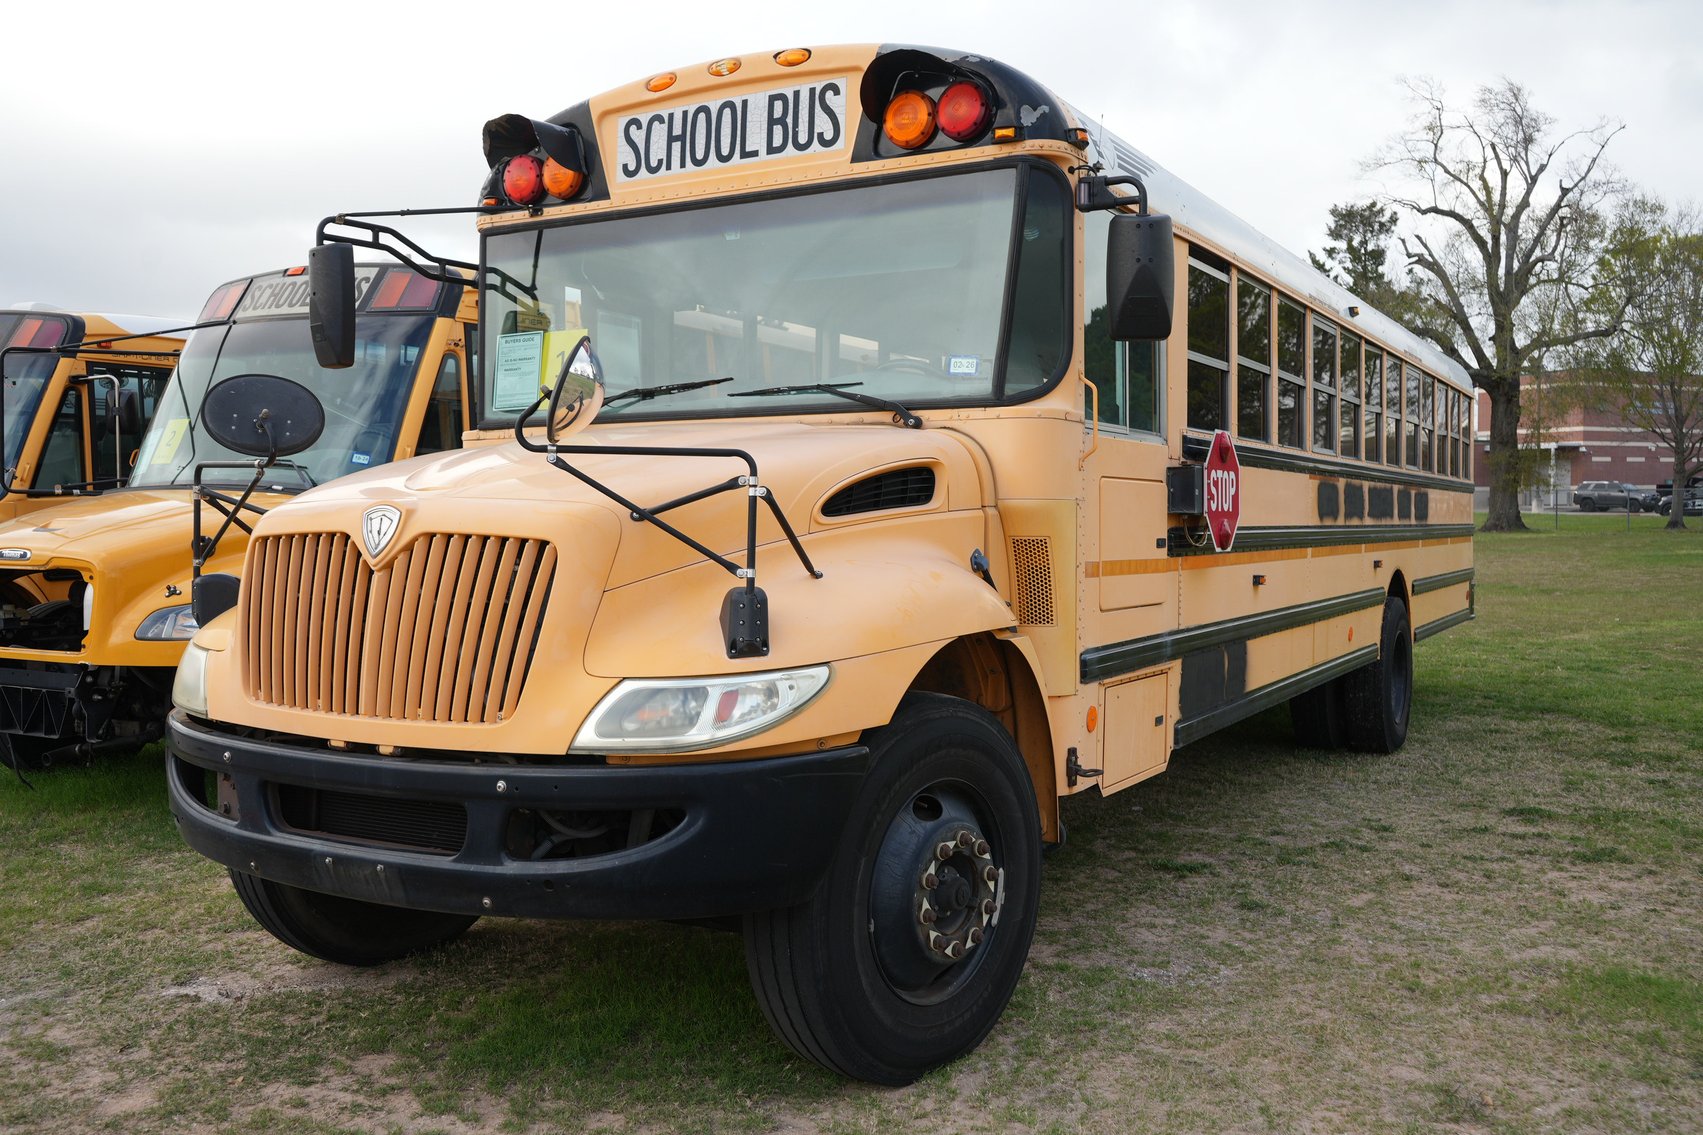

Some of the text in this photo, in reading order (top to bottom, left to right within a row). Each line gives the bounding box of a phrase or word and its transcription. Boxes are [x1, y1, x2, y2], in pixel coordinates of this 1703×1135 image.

[622, 82, 841, 178] SCHOOL BUS
[242, 281, 310, 312] SCHOO
[165, 430, 177, 448] 2
[1210, 469, 1236, 512] STOP
